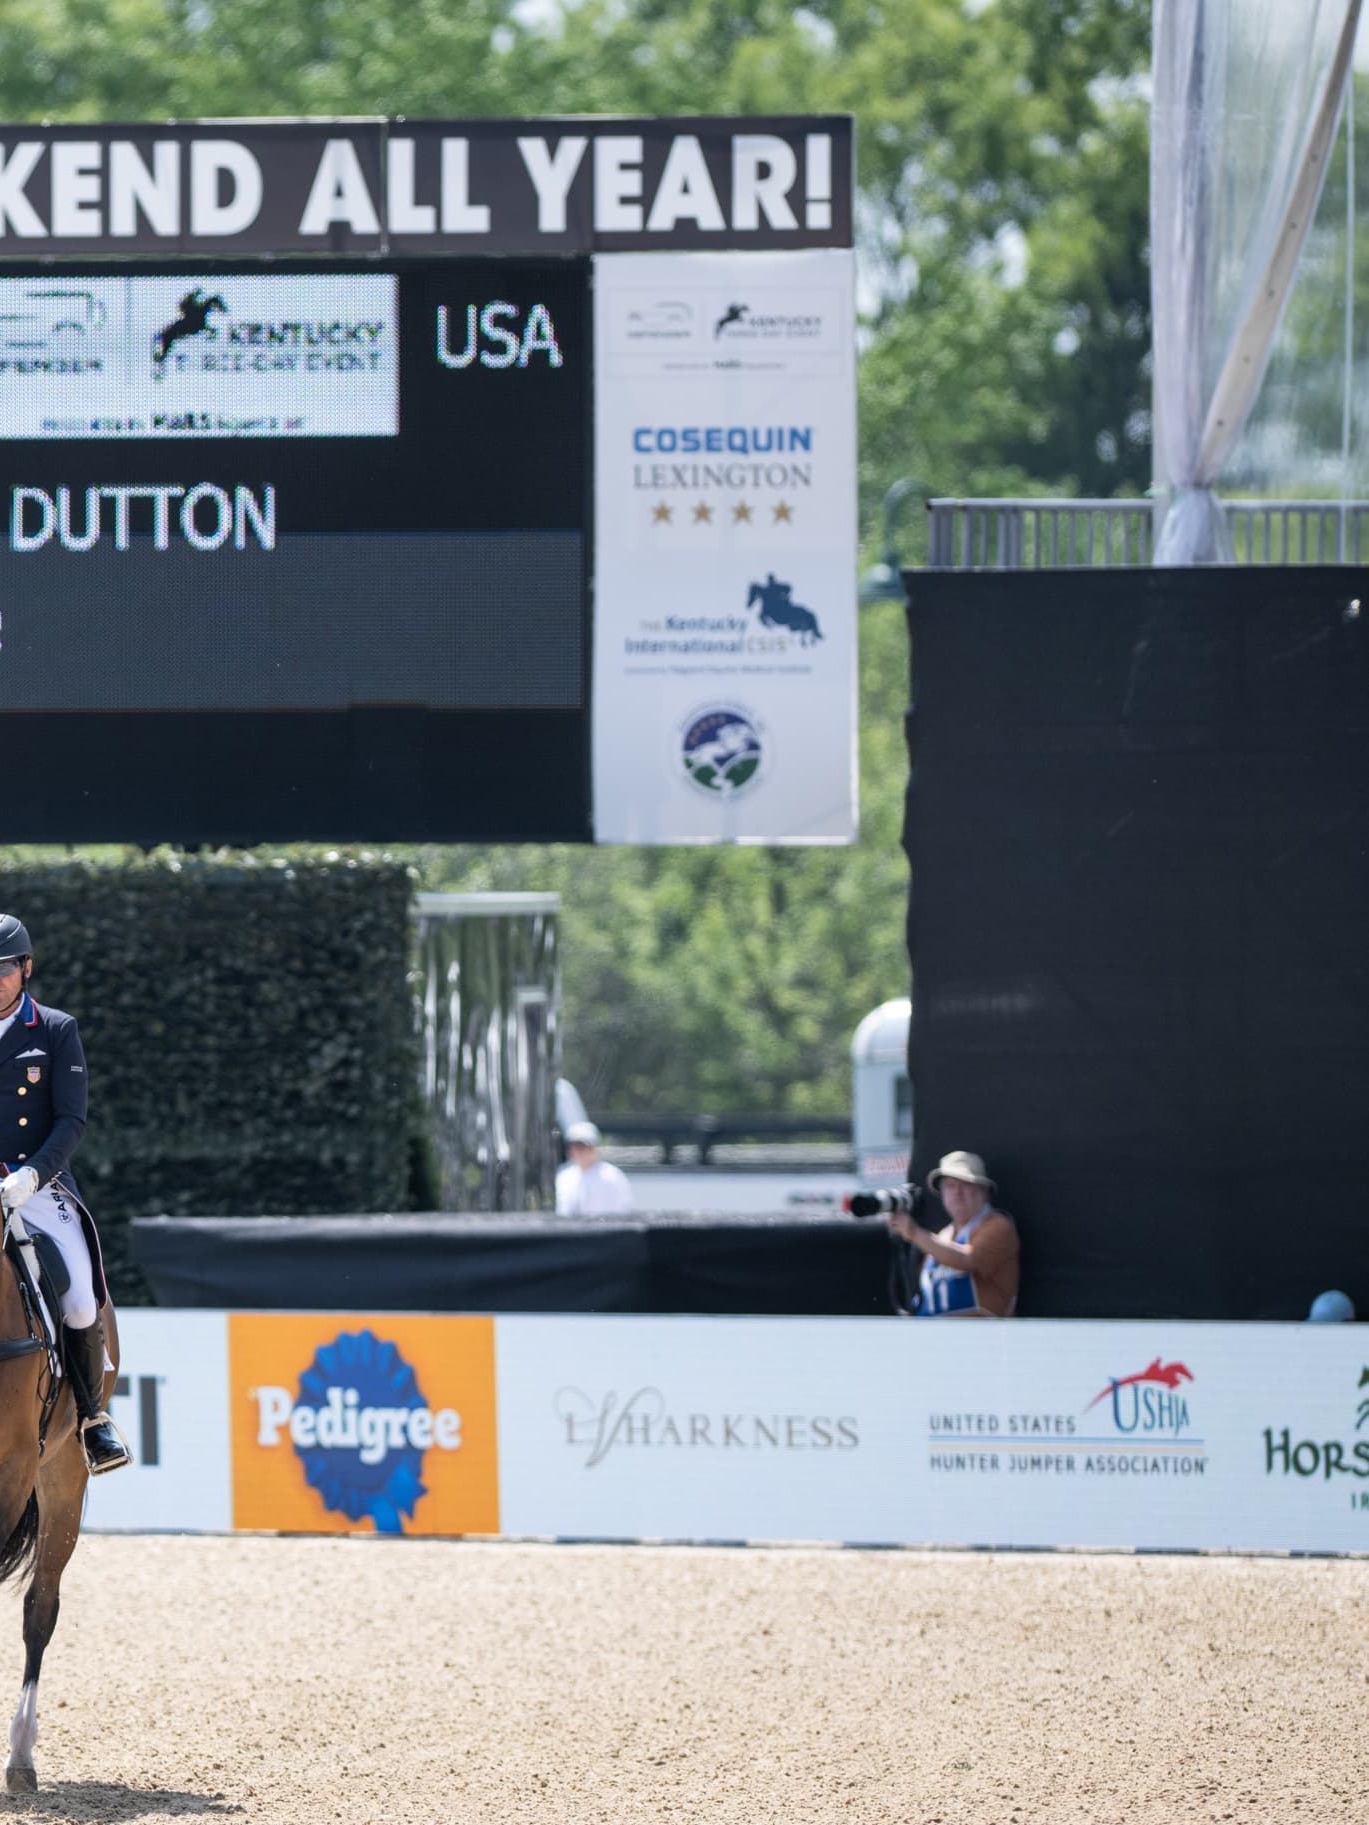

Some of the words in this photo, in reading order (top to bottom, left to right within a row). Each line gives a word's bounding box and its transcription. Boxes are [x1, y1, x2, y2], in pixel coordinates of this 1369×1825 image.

[298, 138, 491, 236] ALL
[517, 134, 832, 233] YEAR!
[229, 322, 384, 345] KENTUCKY
[437, 301, 564, 369] USA
[633, 427, 812, 455] COSEQUIN
[633, 463, 812, 489] LEXINGTON
[9, 482, 277, 553] DUTTON
[665, 615, 748, 633] Kentucky
[624, 637, 745, 655] International
[1109, 1376, 1191, 1436] USHJA
[256, 1385, 463, 1465] Pedigree
[929, 1414, 1000, 1434] UNITED
[1008, 1415, 1077, 1435] STATES
[930, 1453, 1001, 1473] HUNTER
[1009, 1454, 1077, 1474] JUMPER
[1084, 1455, 1207, 1476] ASSOCIATION
